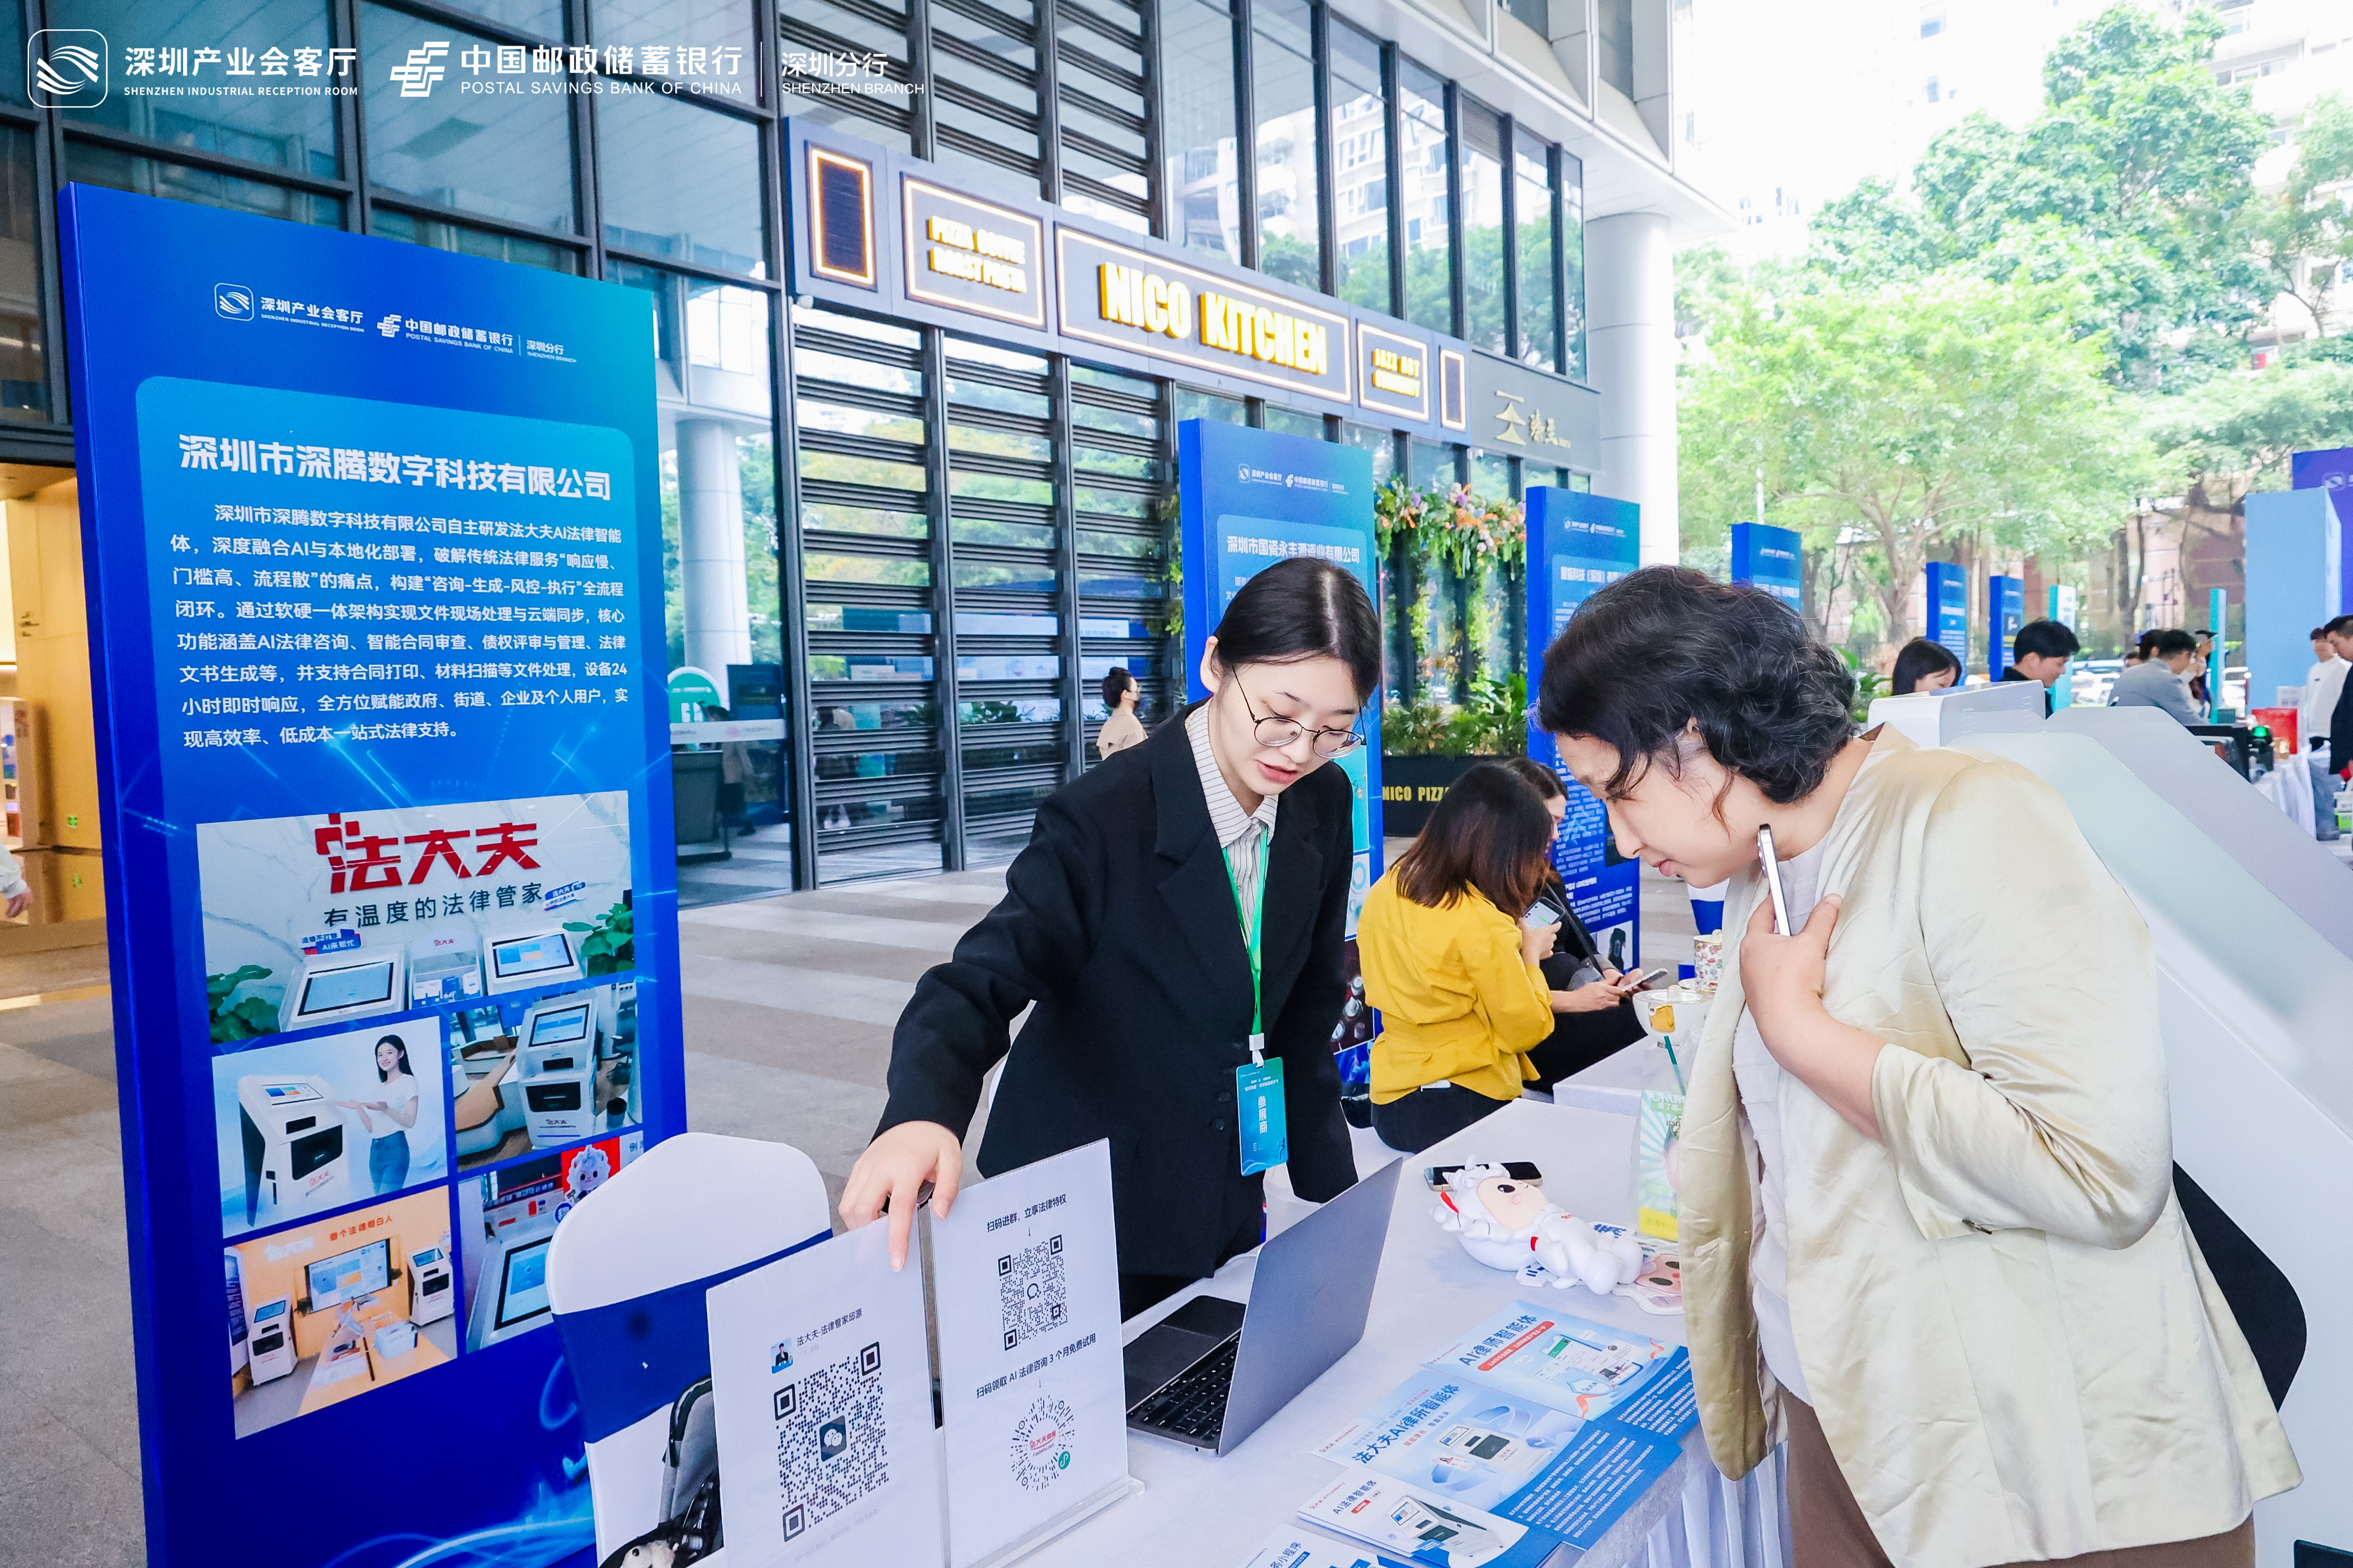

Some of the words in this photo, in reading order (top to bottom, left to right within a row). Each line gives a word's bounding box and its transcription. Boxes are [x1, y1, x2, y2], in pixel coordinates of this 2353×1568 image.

[928, 215, 974, 251] PIZZA
[261, 296, 364, 324] 深圳产业会客厅
[1099, 261, 1191, 339] NICO
[1199, 291, 1327, 375] KITCHEN
[405, 318, 513, 346] 中国邮政储蓄银行
[406, 333, 431, 342] POSTAL
[434, 337, 462, 346] SAVINGS
[526, 339, 564, 355] 深圳分行
[179, 433, 611, 501] 深圳市深腾数字科技有限公司
[214, 504, 622, 543] 深圳市深腾数字科技有限公司自主研发法大夫AI法律智能
[175, 600, 625, 624] 闭环。通过软硬一体架构实现文件现场处理与云端同步，核心
[176, 632, 626, 651] 功能涵盖AI法律咨询、智能合同审查、债权评审与管理、法律
[179, 662, 628, 683] 文书生成等，并支持合同打印、材料扫描等文件处理，设备24
[182, 688, 628, 716] 小时即时响应，全方位赋能政府、街道、企业及个人用户，实
[184, 721, 457, 748] 现高效率、低成本一站式法律支持。
[1382, 785, 1412, 802] NICO
[315, 813, 541, 894] 法大夫
[324, 882, 542, 928] 有温度的法律管家
[1258, 1095, 1268, 1135] 参展商
[987, 1193, 1066, 1233] 扫码进群，立享法律特权
[796, 1307, 862, 1347] 法大夫-法律管家邱源
[1459, 1315, 1538, 1366] AI律师智能体
[976, 1375, 1008, 1399] 扫码领取
[1009, 1371, 1017, 1382] AI
[1019, 1356, 1048, 1379] 法律咨询
[1049, 1354, 1054, 1363] 3
[1055, 1333, 1096, 1361] 个月免费试用
[1351, 1383, 1460, 1464] 法大夫AI律所智能体
